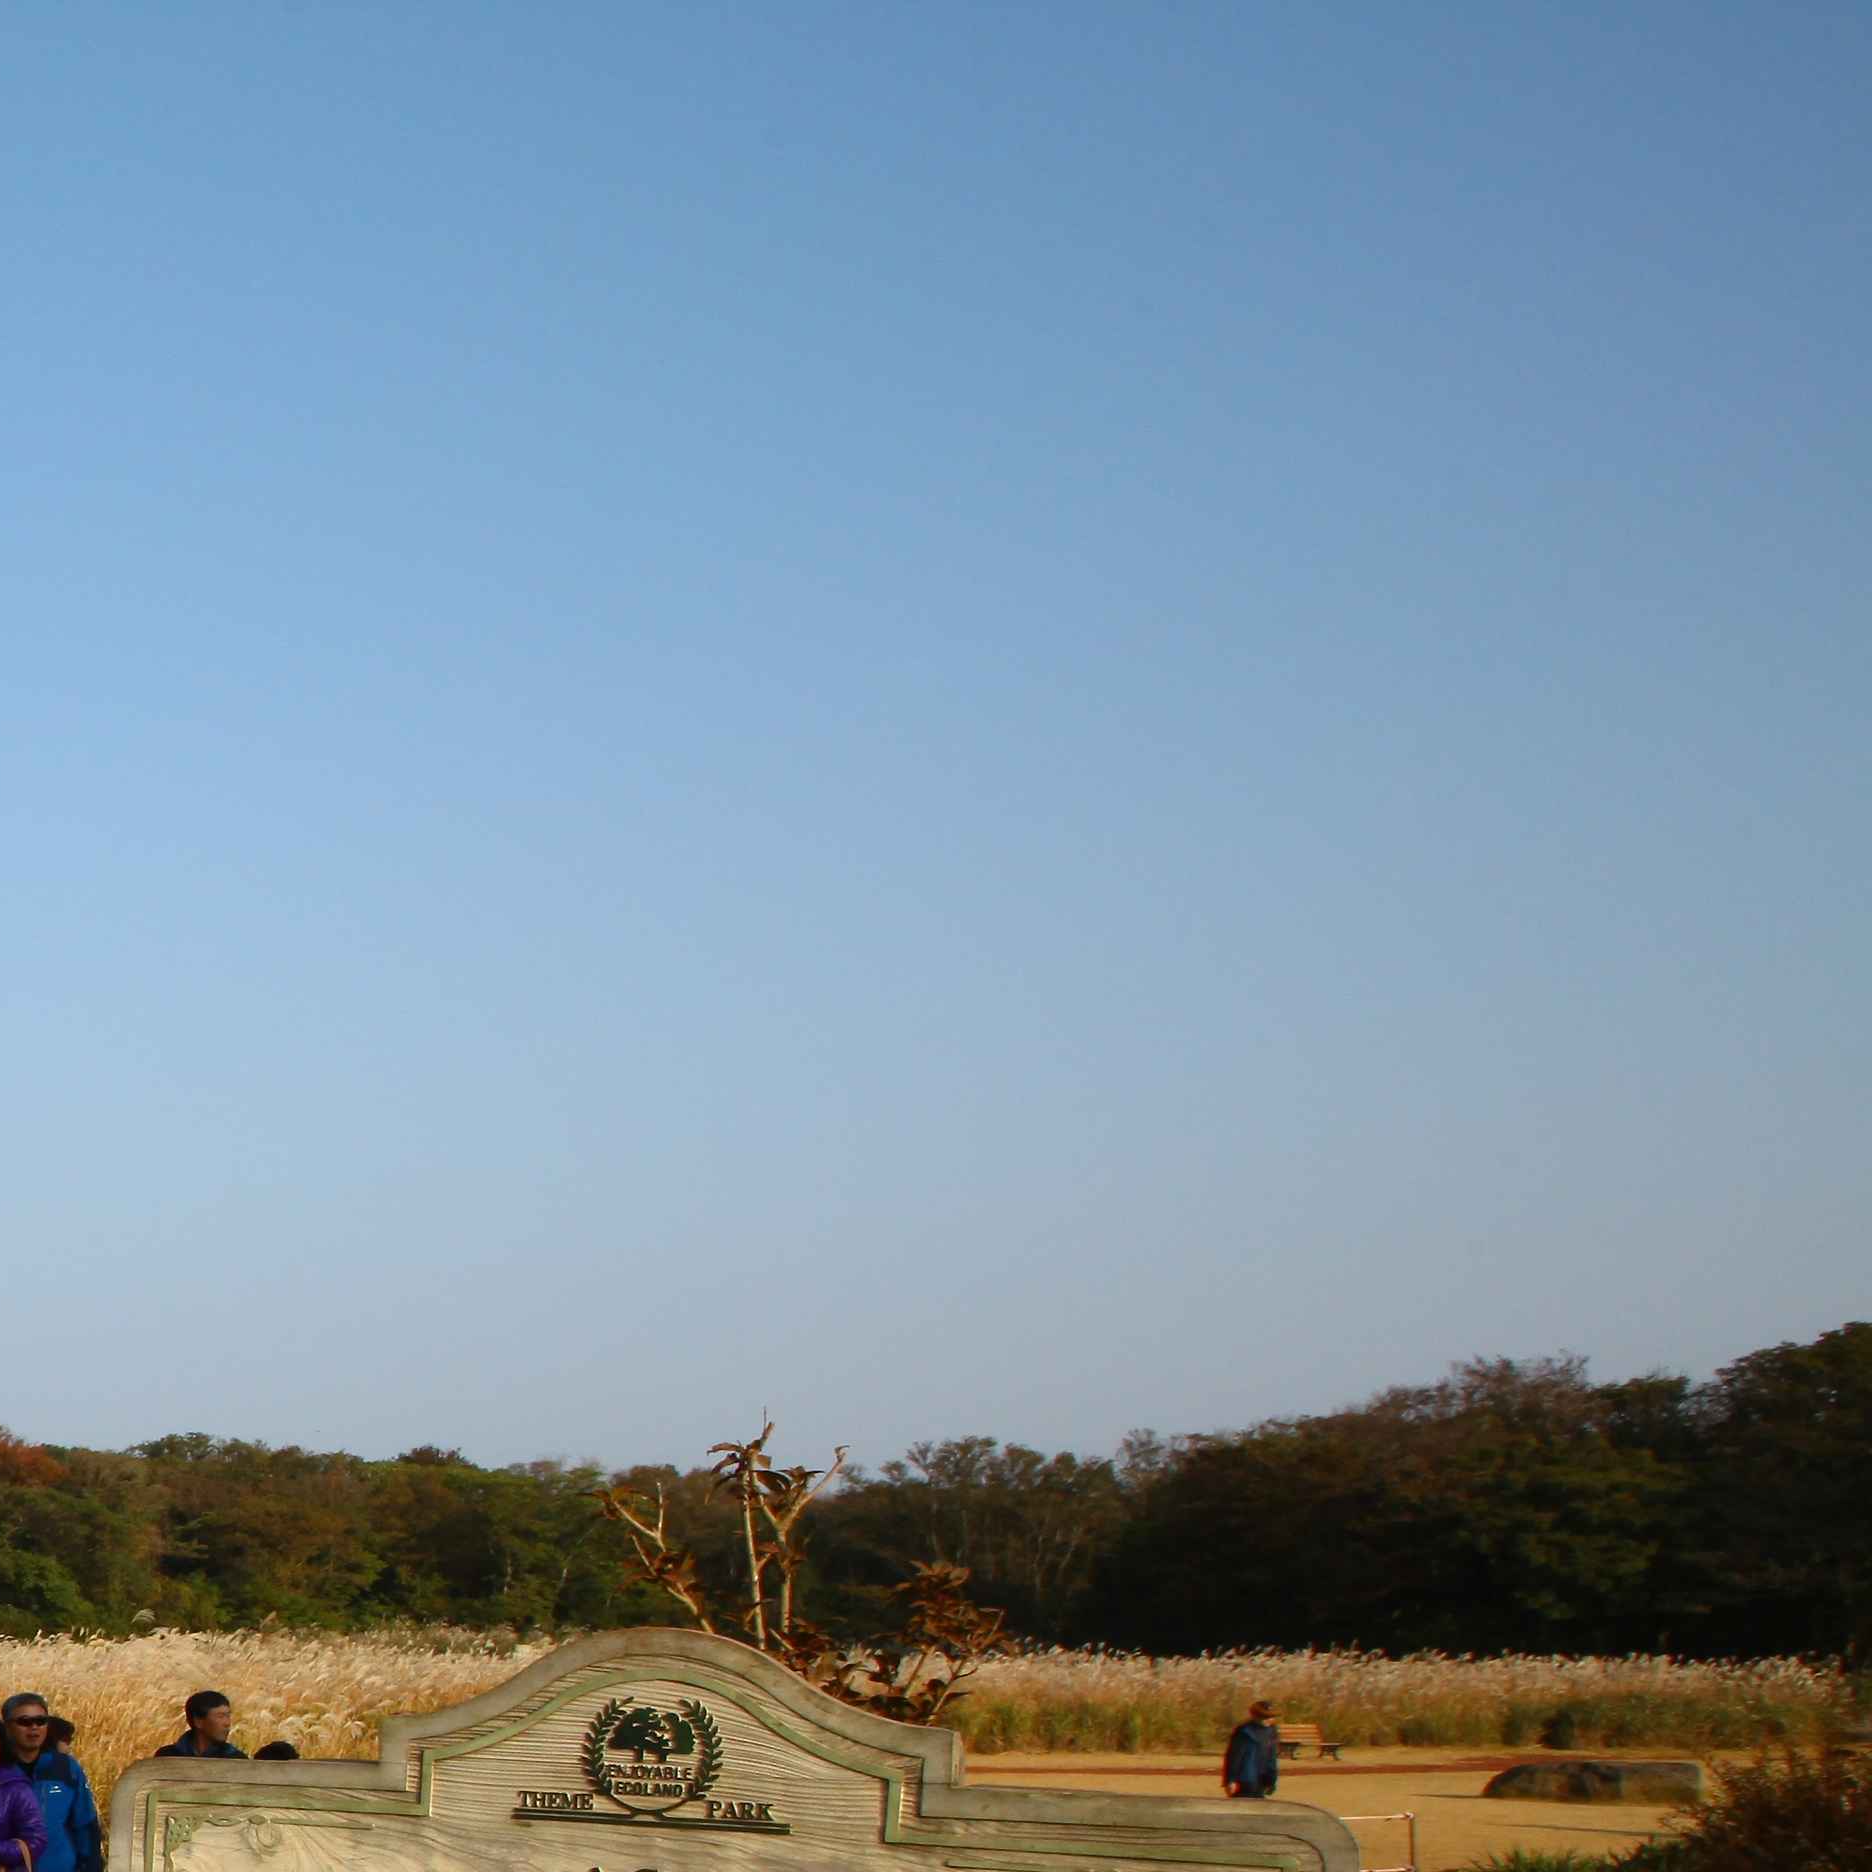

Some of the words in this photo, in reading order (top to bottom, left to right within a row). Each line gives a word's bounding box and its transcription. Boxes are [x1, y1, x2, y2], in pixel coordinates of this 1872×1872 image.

[607, 1763, 693, 1781] ENJOYABLE
[614, 1780, 685, 1798] ECOLAND
[518, 1790, 594, 1810] THEME
[706, 1800, 774, 1820] PARK
